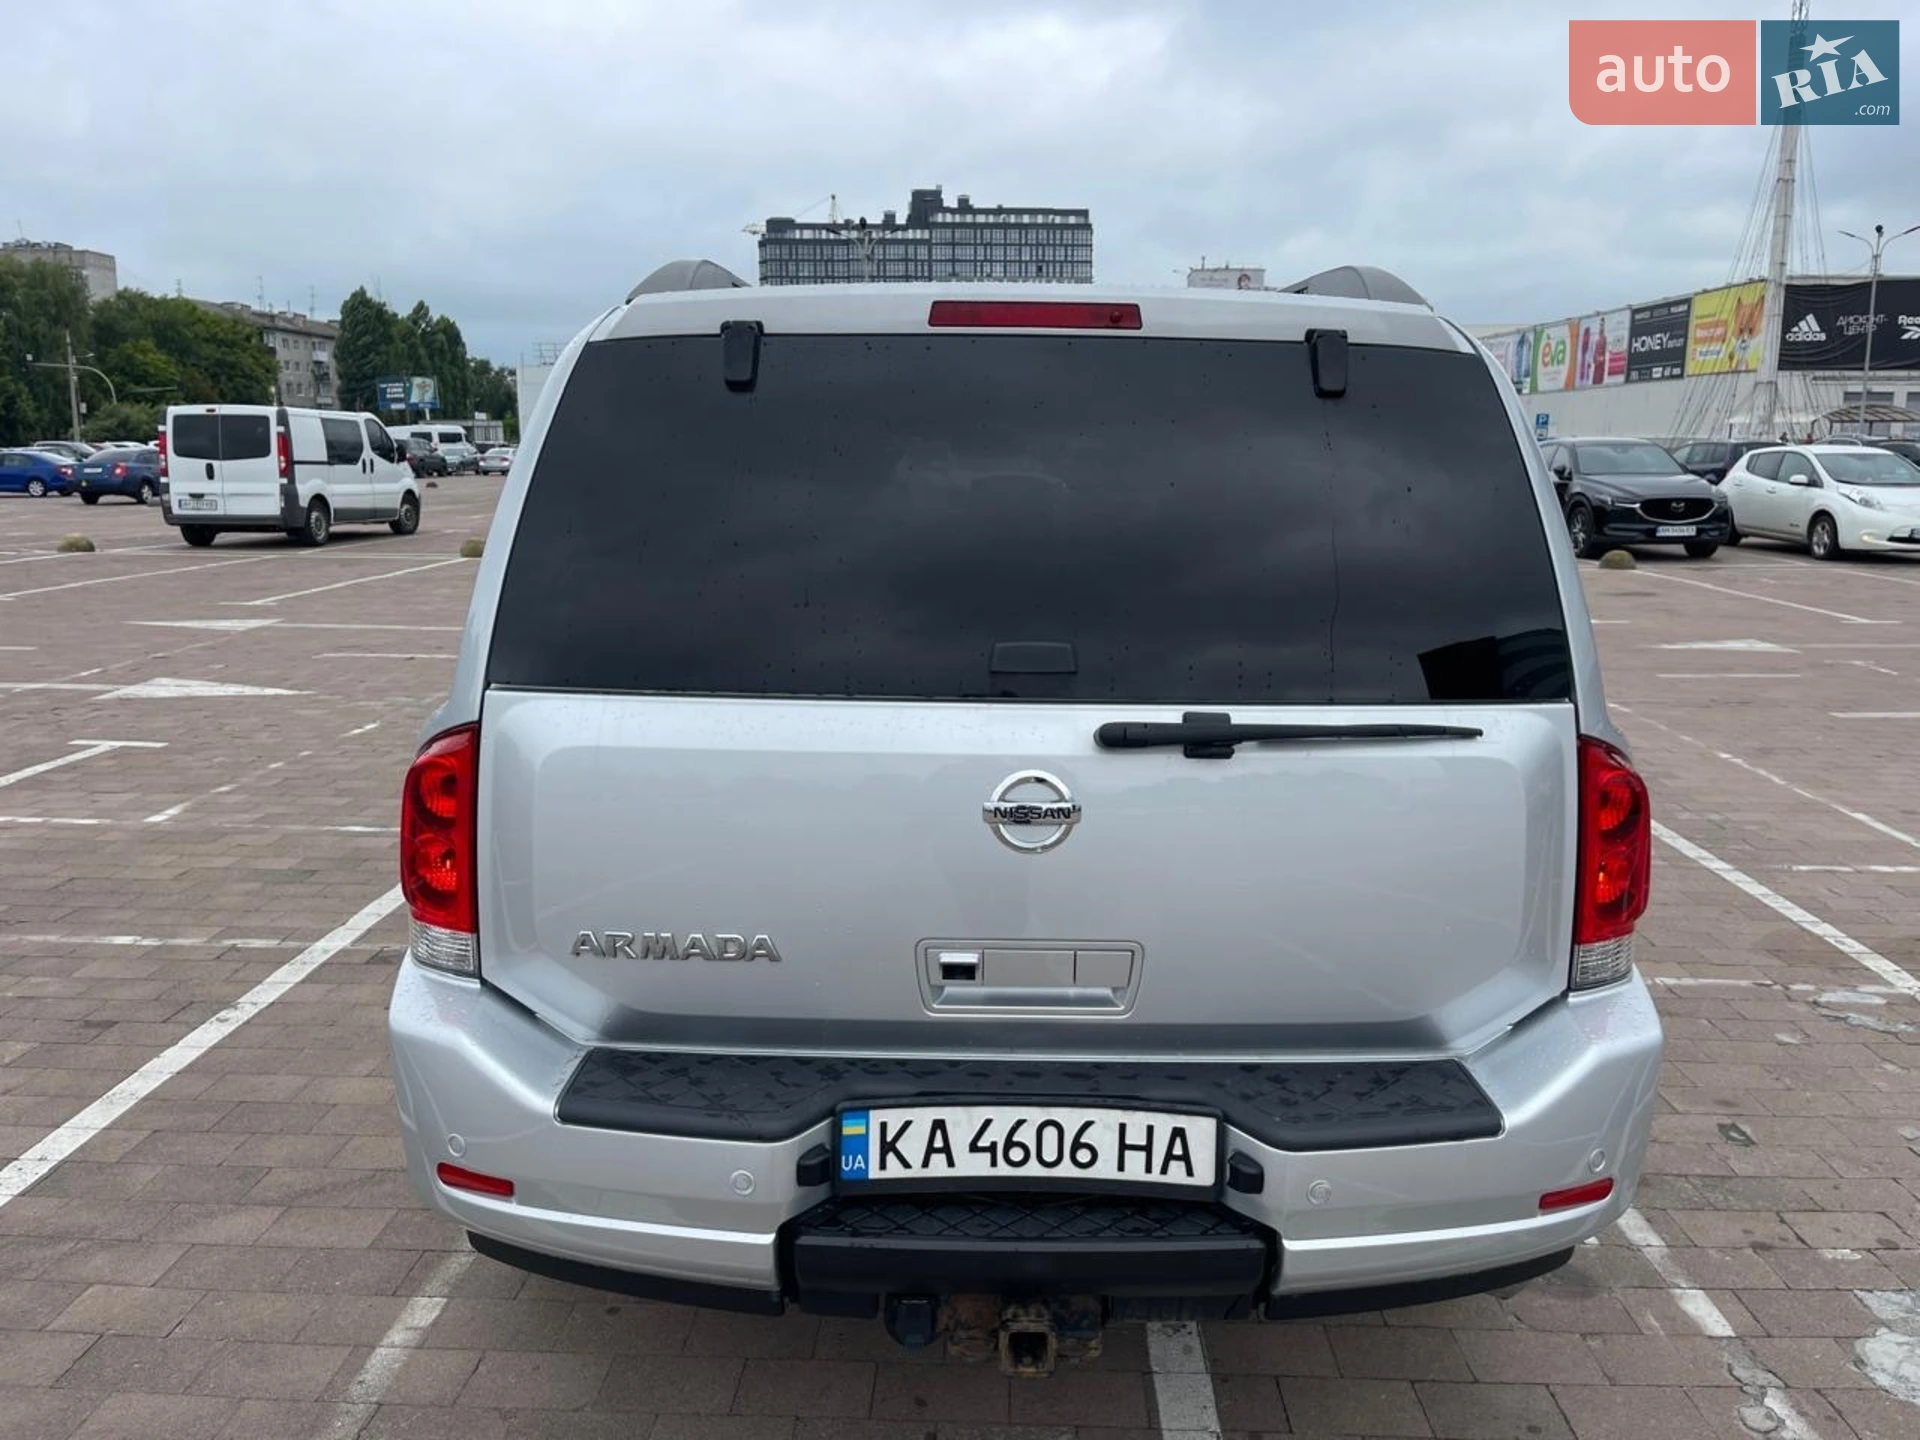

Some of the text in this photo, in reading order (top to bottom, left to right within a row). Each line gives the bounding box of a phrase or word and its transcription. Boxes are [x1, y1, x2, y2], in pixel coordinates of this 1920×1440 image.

[1631, 331, 1670, 353] HONEY
[1786, 330, 1827, 342] adidas
[993, 804, 1071, 819] NISSAN
[570, 931, 782, 961] ARMADA
[878, 1118, 1195, 1178] KA 4606 HA
[841, 1154, 866, 1171] UA
